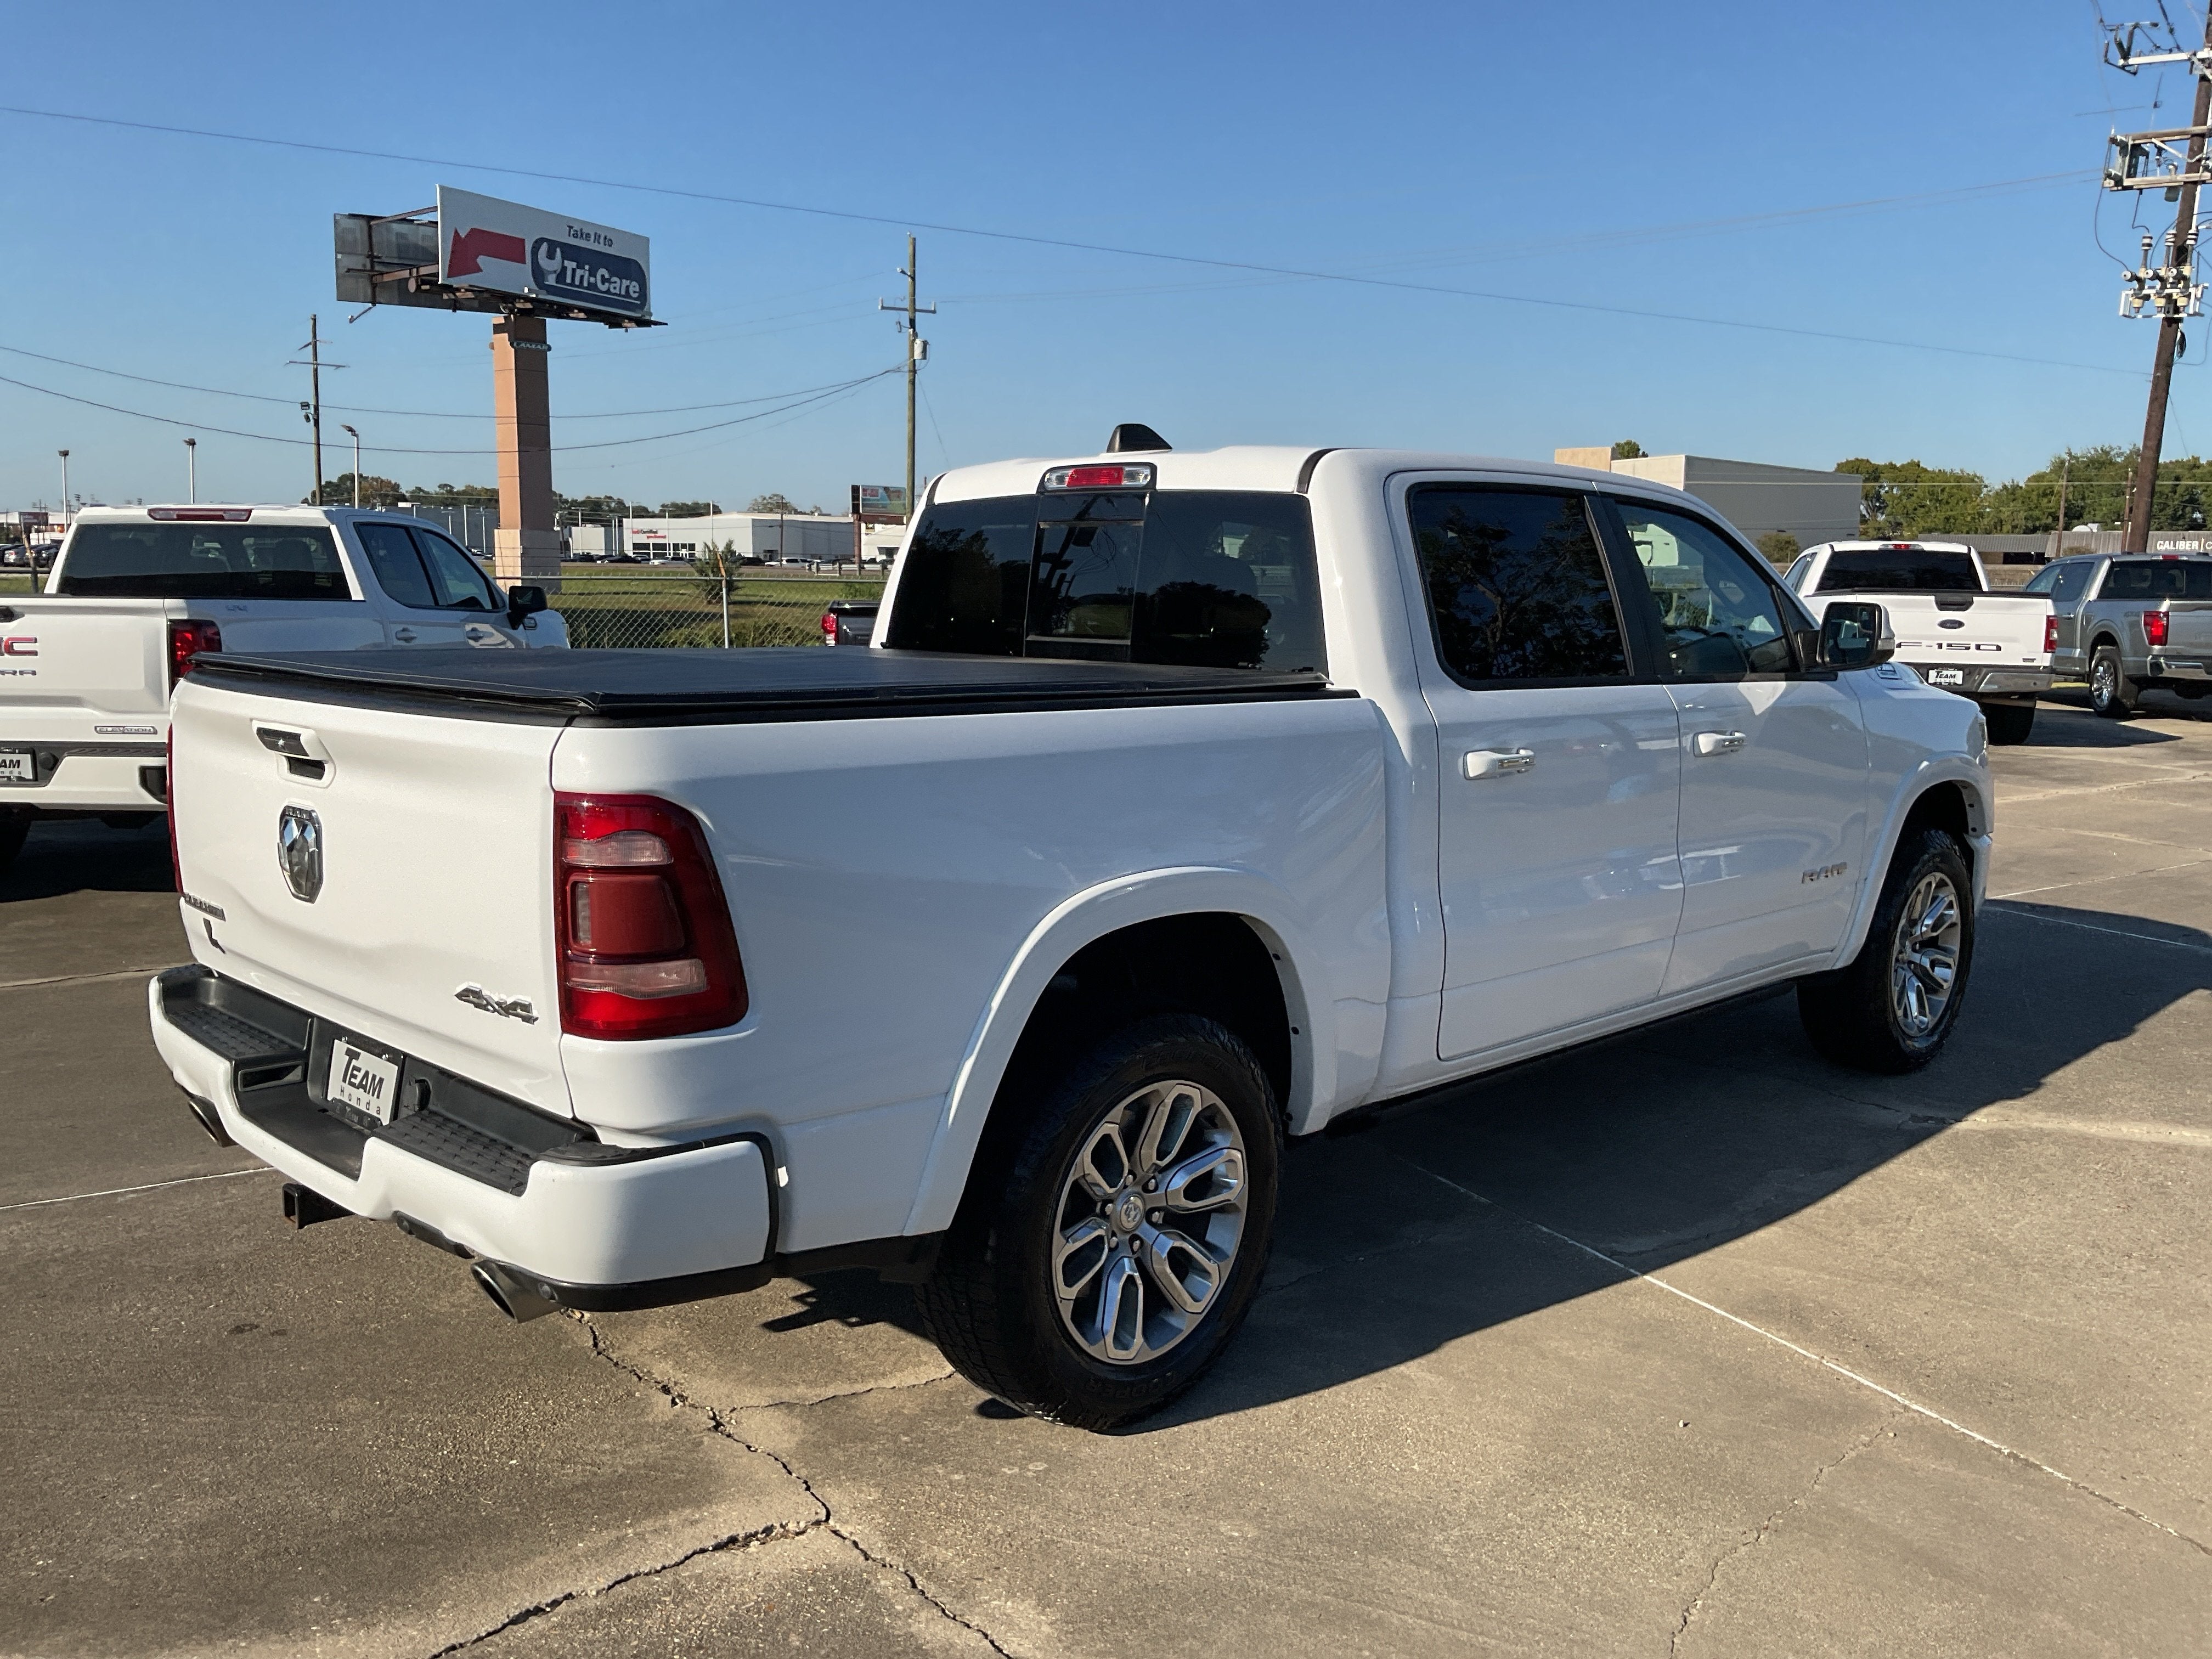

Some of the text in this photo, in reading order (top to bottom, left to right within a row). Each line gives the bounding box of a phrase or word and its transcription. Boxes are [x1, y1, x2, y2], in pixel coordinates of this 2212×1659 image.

[567, 225, 591, 242] Take
[604, 235, 614, 247] to
[563, 259, 639, 298] Tri-Care
[2157, 540, 2199, 550] CALIBER
[0, 637, 38, 656] C
[1896, 641, 2002, 651] F-150
[1935, 670, 1957, 679] TEAM
[342, 1046, 385, 1099] TEAM
[340, 1085, 381, 1116] Honda
